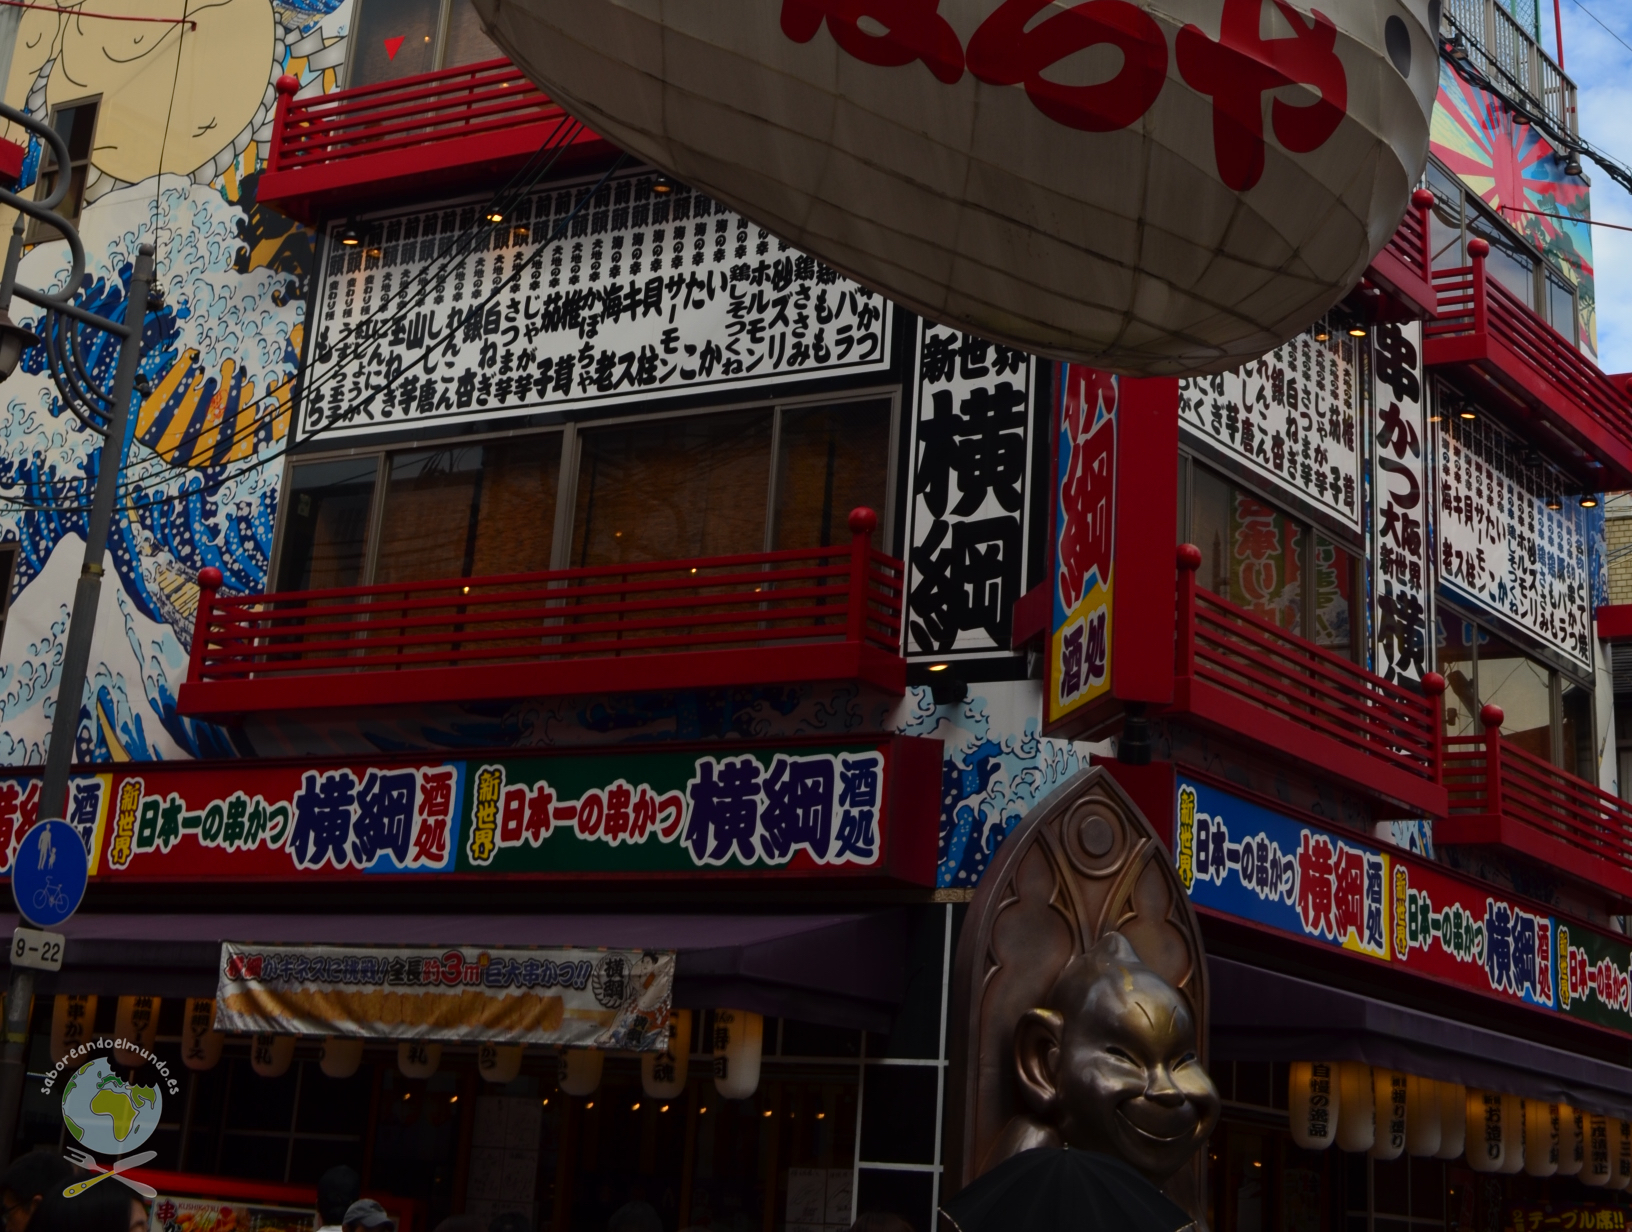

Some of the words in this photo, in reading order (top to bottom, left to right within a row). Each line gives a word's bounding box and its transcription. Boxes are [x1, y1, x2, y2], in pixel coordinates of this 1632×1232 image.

[746, 260, 771, 373] ホルモン
[834, 272, 858, 361] バラ
[910, 381, 1028, 653] 横綱
[1060, 609, 1107, 700] 酒処
[111, 782, 141, 865] 新世界
[136, 796, 290, 849] 日本一の串かつ
[289, 772, 417, 866] 横綱
[412, 771, 453, 863] 酒処
[471, 769, 501, 860] 新世界
[501, 783, 683, 843] 日本一の串かつ
[686, 759, 836, 861] 横綱
[834, 758, 879, 859] 酒処
[1197, 818, 1297, 901] 日本一の串かつ
[1299, 833, 1365, 943] 横綱
[1366, 856, 1384, 950] 酒処
[15, 938, 61, 963] 9-22
[1408, 894, 1484, 960] 日本一の串かつ
[1486, 902, 1538, 992] 横綱
[1485, 1107, 1502, 1160] お造り
